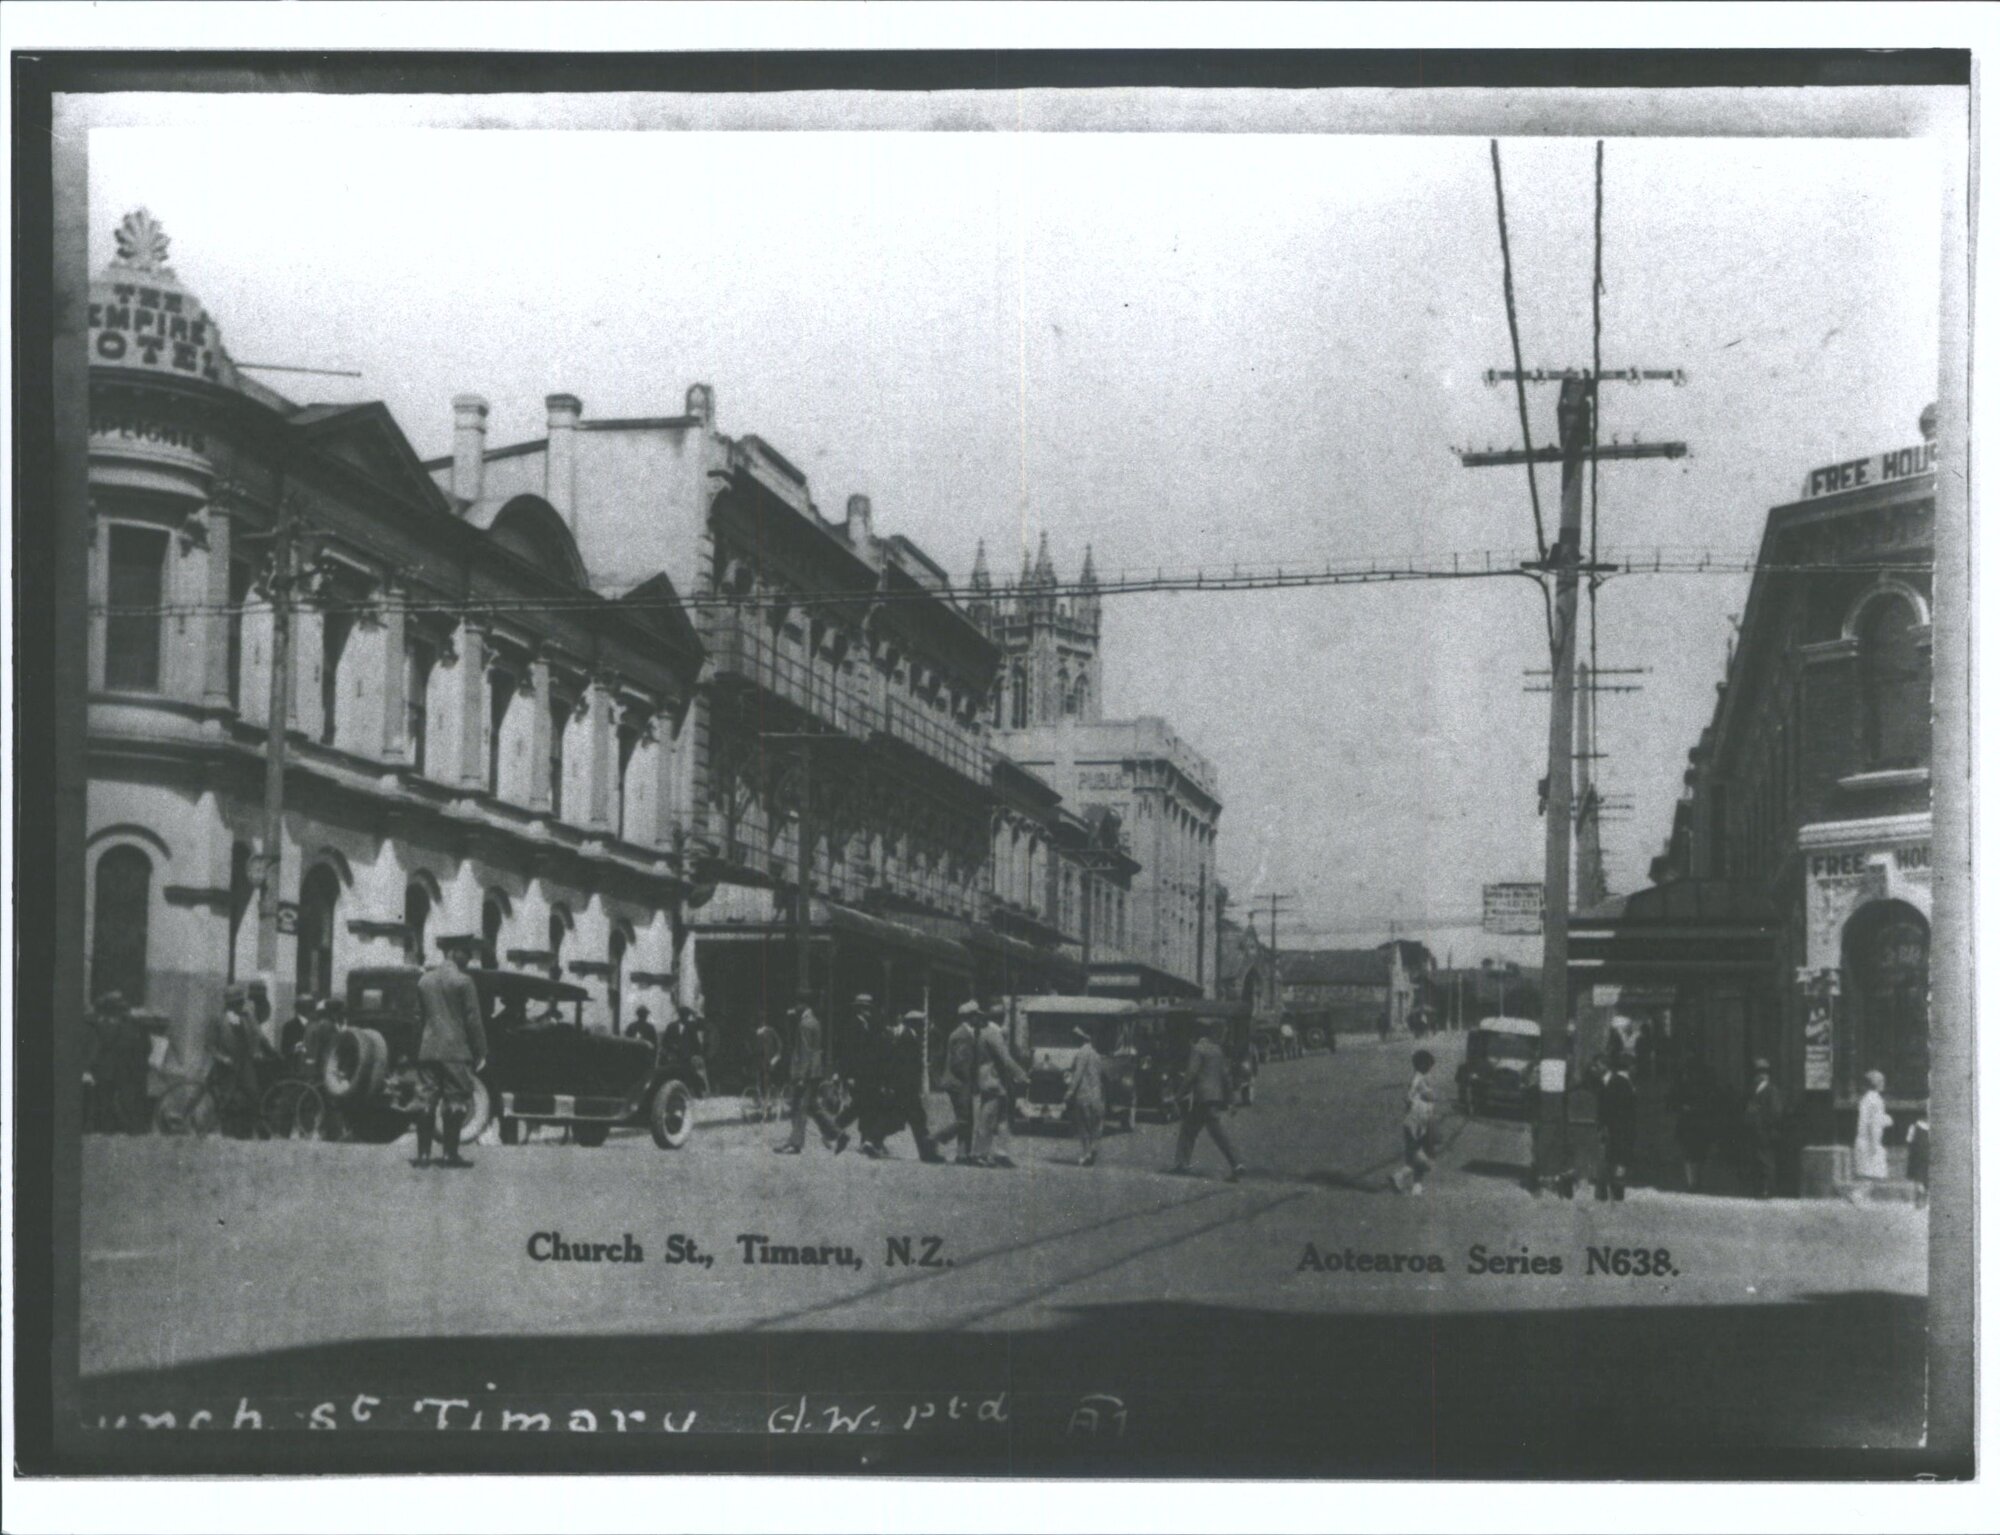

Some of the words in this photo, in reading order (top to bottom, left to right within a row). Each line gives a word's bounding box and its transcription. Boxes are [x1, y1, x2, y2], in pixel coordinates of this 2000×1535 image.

[88, 303, 206, 346] EMPIRE
[1812, 456, 1870, 496] FREE
[1811, 851, 1867, 876] FREE
